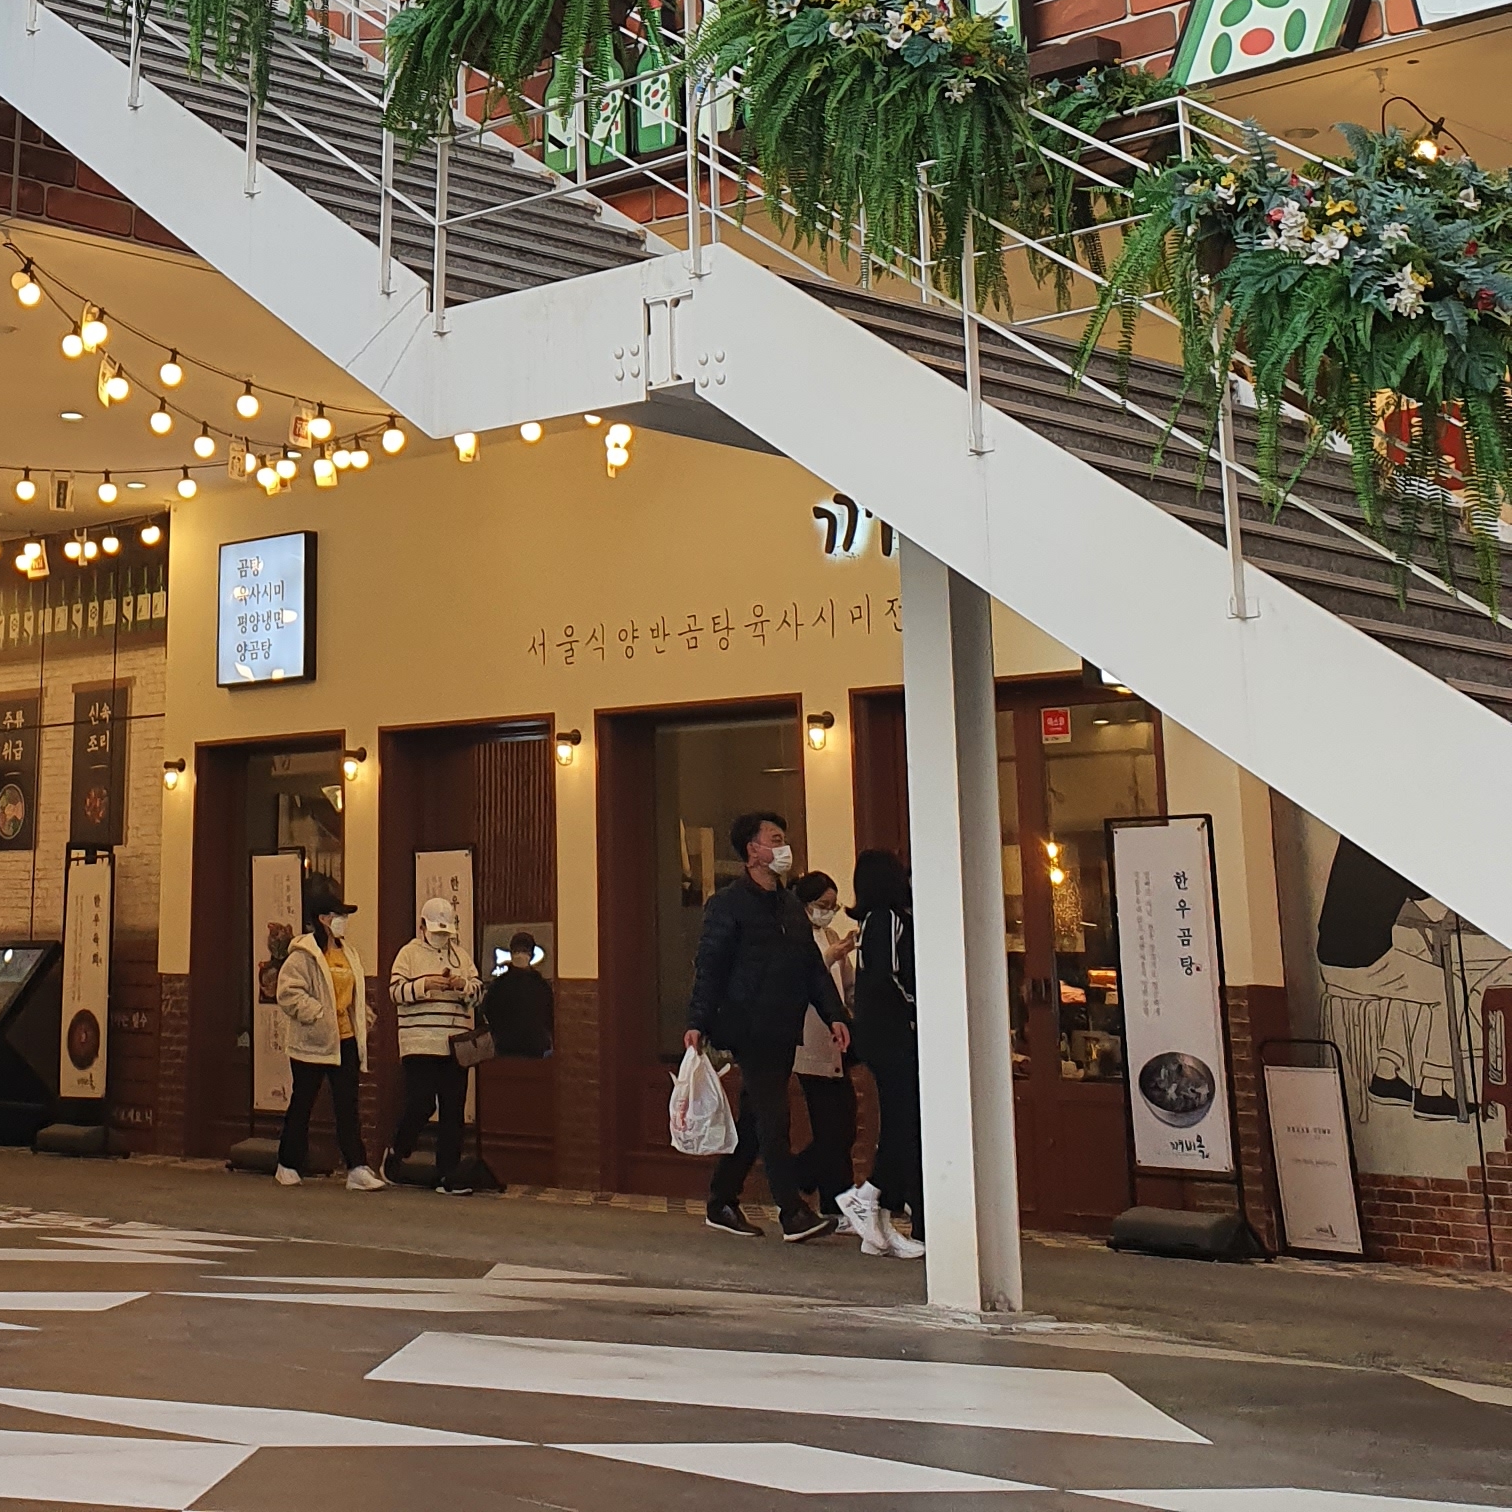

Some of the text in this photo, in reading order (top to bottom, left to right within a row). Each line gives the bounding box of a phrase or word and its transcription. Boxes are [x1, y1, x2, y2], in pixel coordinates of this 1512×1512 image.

[236, 555, 261, 579] 곰탕
[236, 579, 285, 606] 육사시미
[236, 638, 273, 663] 양곰탕
[88, 702, 112, 726] 신속
[86, 730, 110, 753] 조리
[1173, 870, 1195, 977] 한우곰탕
